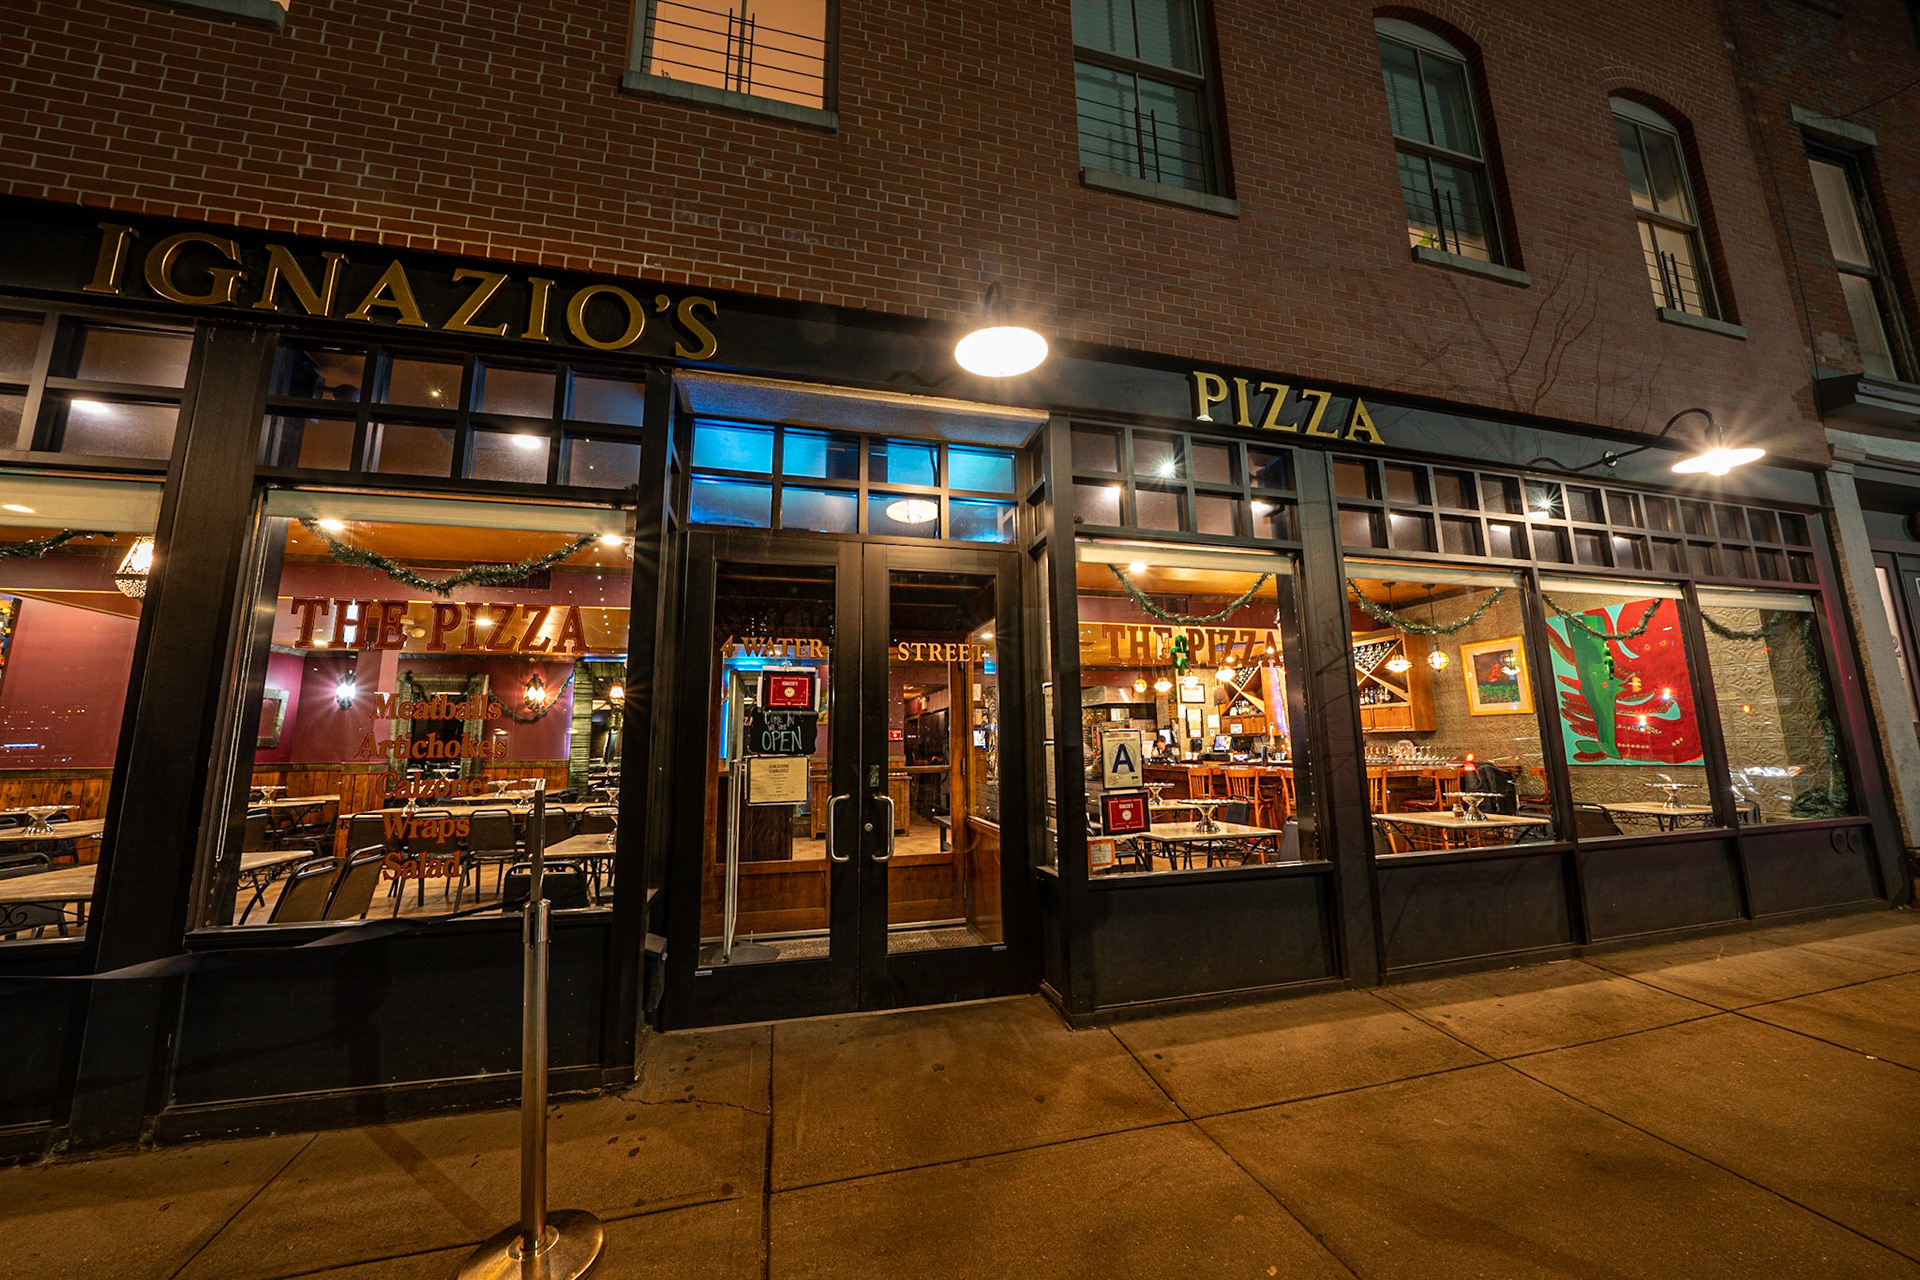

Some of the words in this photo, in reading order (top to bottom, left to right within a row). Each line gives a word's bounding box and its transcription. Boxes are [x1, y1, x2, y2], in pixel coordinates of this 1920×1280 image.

[1192, 370, 1386, 446] PIZZA
[291, 597, 408, 651] THE
[427, 602, 591, 654] PIZZA
[719, 634, 735, 658] 4
[740, 636, 824, 659] WATER
[897, 641, 986, 663] STREET
[1102, 624, 1173, 666] THE
[1185, 628, 1282, 667] PIZZA
[370, 692, 502, 720] Meatballs
[354, 732, 508, 760] Artichokes
[761, 725, 803, 752] OPEN
[1111, 743, 1135, 773] A
[375, 770, 484, 800] Calzone
[381, 812, 471, 845] Wraps
[383, 850, 463, 881] Salad
